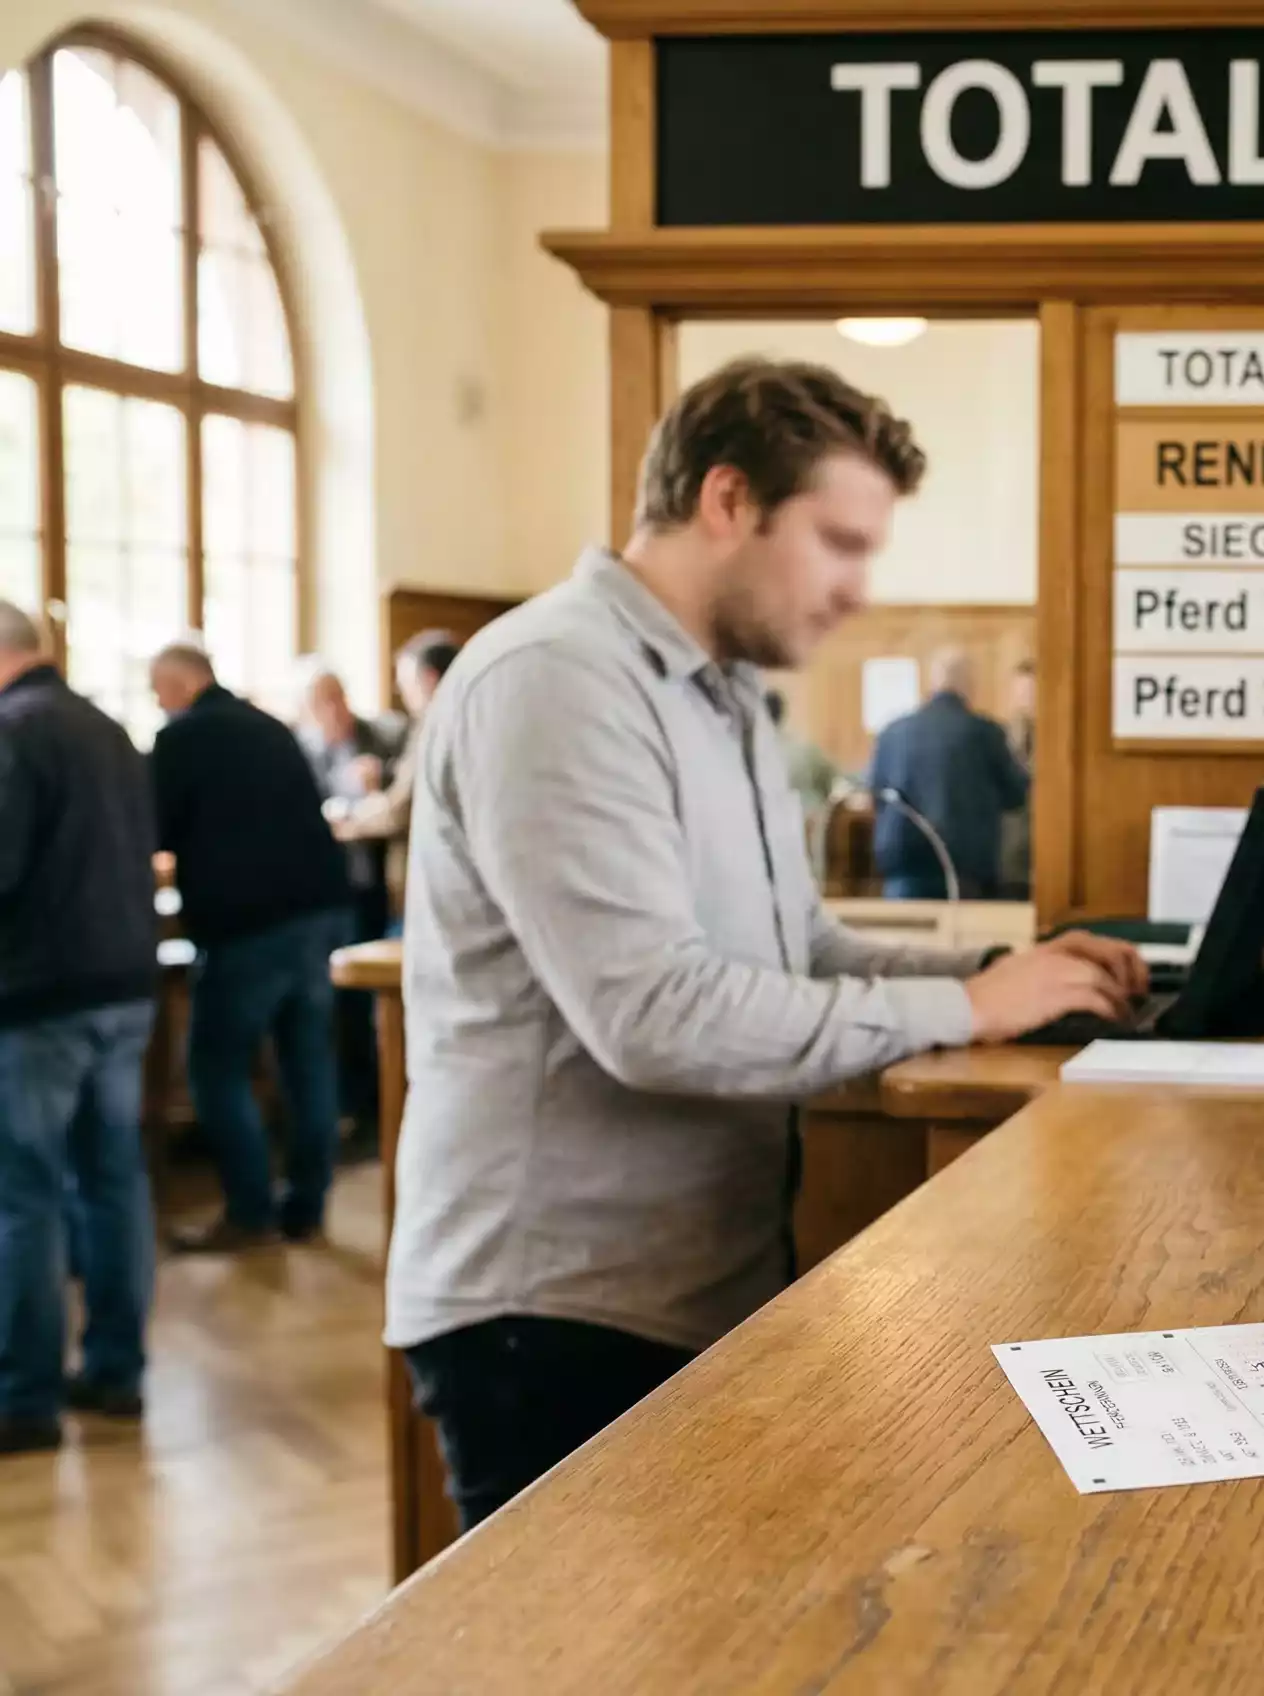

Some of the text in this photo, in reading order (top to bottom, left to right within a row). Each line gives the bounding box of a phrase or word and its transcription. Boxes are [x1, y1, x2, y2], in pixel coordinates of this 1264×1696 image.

[1135, 589, 1246, 631] Pferd
[1135, 676, 1246, 719] Pferd
[1040, 1369, 1114, 1450] WETTSCHEIN
